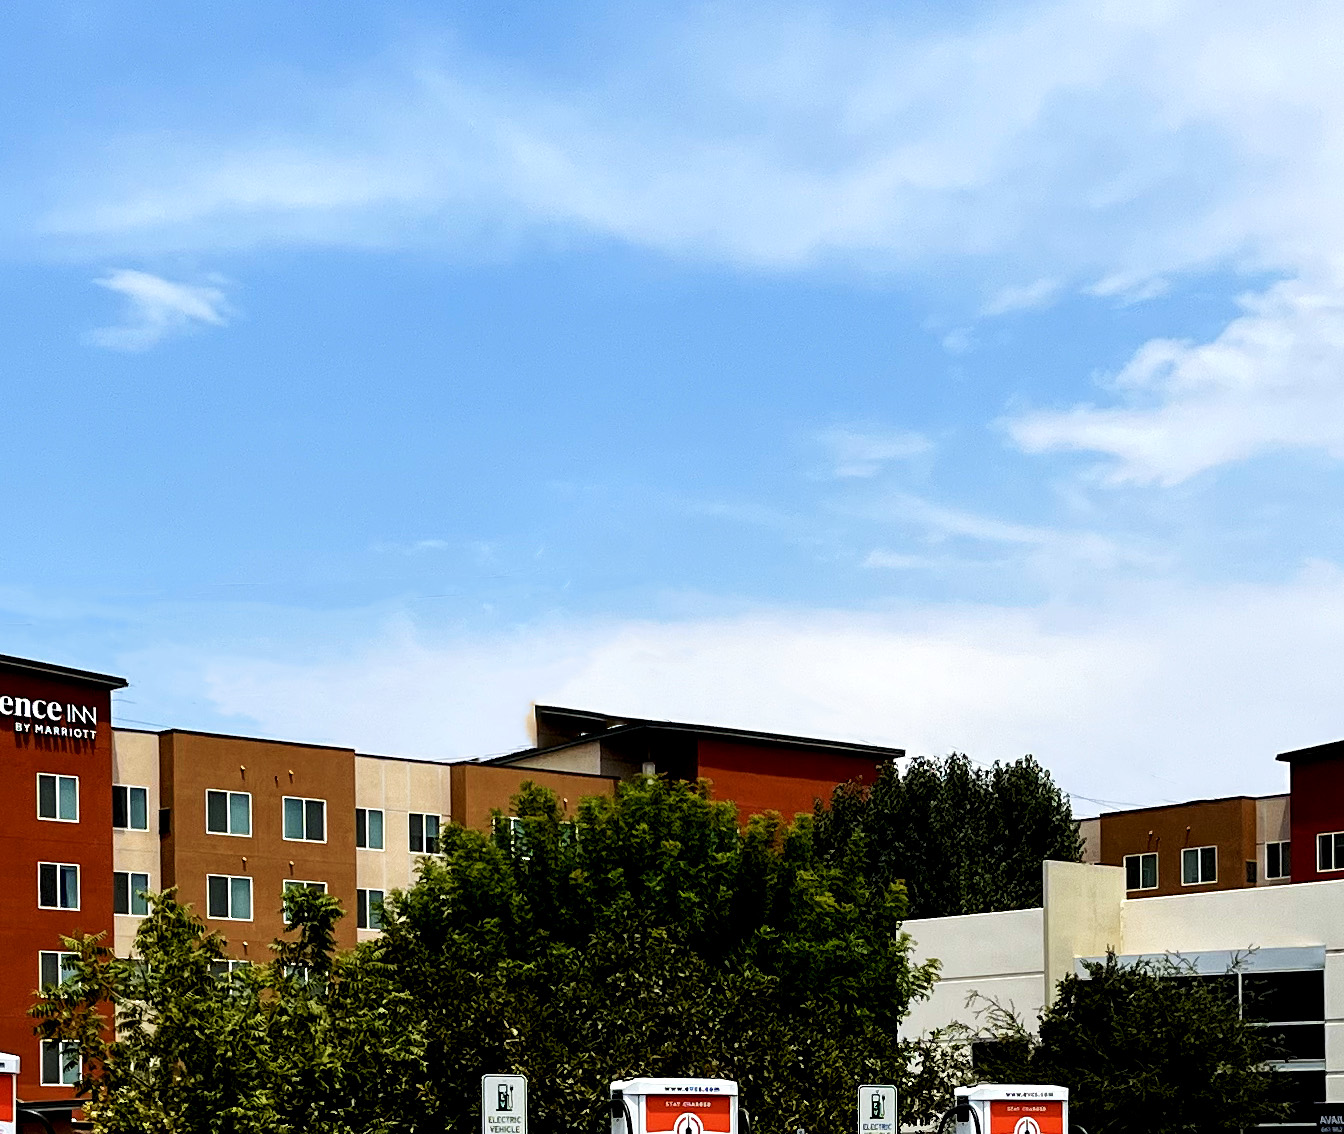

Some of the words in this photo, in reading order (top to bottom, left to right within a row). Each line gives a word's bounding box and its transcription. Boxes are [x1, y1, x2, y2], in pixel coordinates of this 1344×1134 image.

[66, 703, 97, 726] INN
[14, 722, 31, 733] BY
[34, 723, 97, 740] MARRIOTT
[488, 1116, 522, 1124] ELECTRIC
[489, 1126, 520, 1134] VEHICLE
[862, 1123, 893, 1131] ELECTRIC
